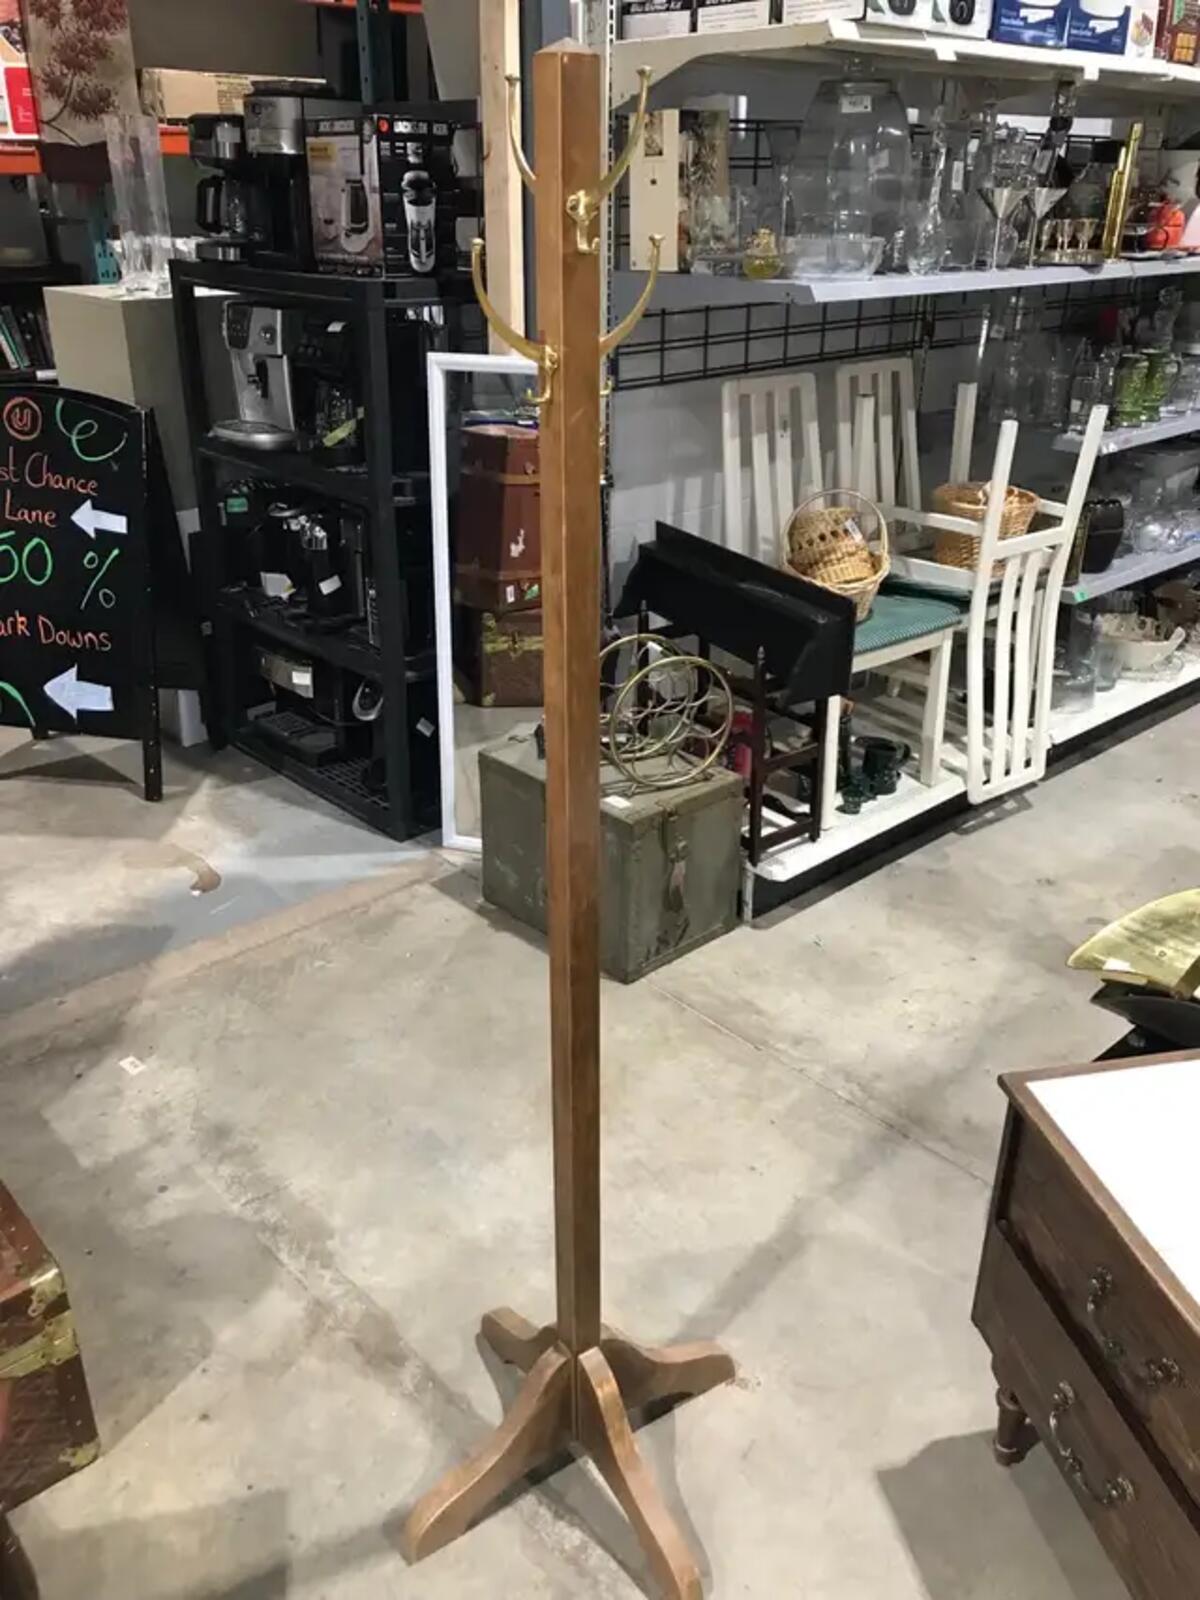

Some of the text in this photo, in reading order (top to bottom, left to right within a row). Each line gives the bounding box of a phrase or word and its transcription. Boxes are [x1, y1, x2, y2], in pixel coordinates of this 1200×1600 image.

[25, 452, 99, 496] Chance
[5, 489, 57, 527] Lane
[0, 530, 121, 611] 50 %
[38, 614, 112, 652] Downs
